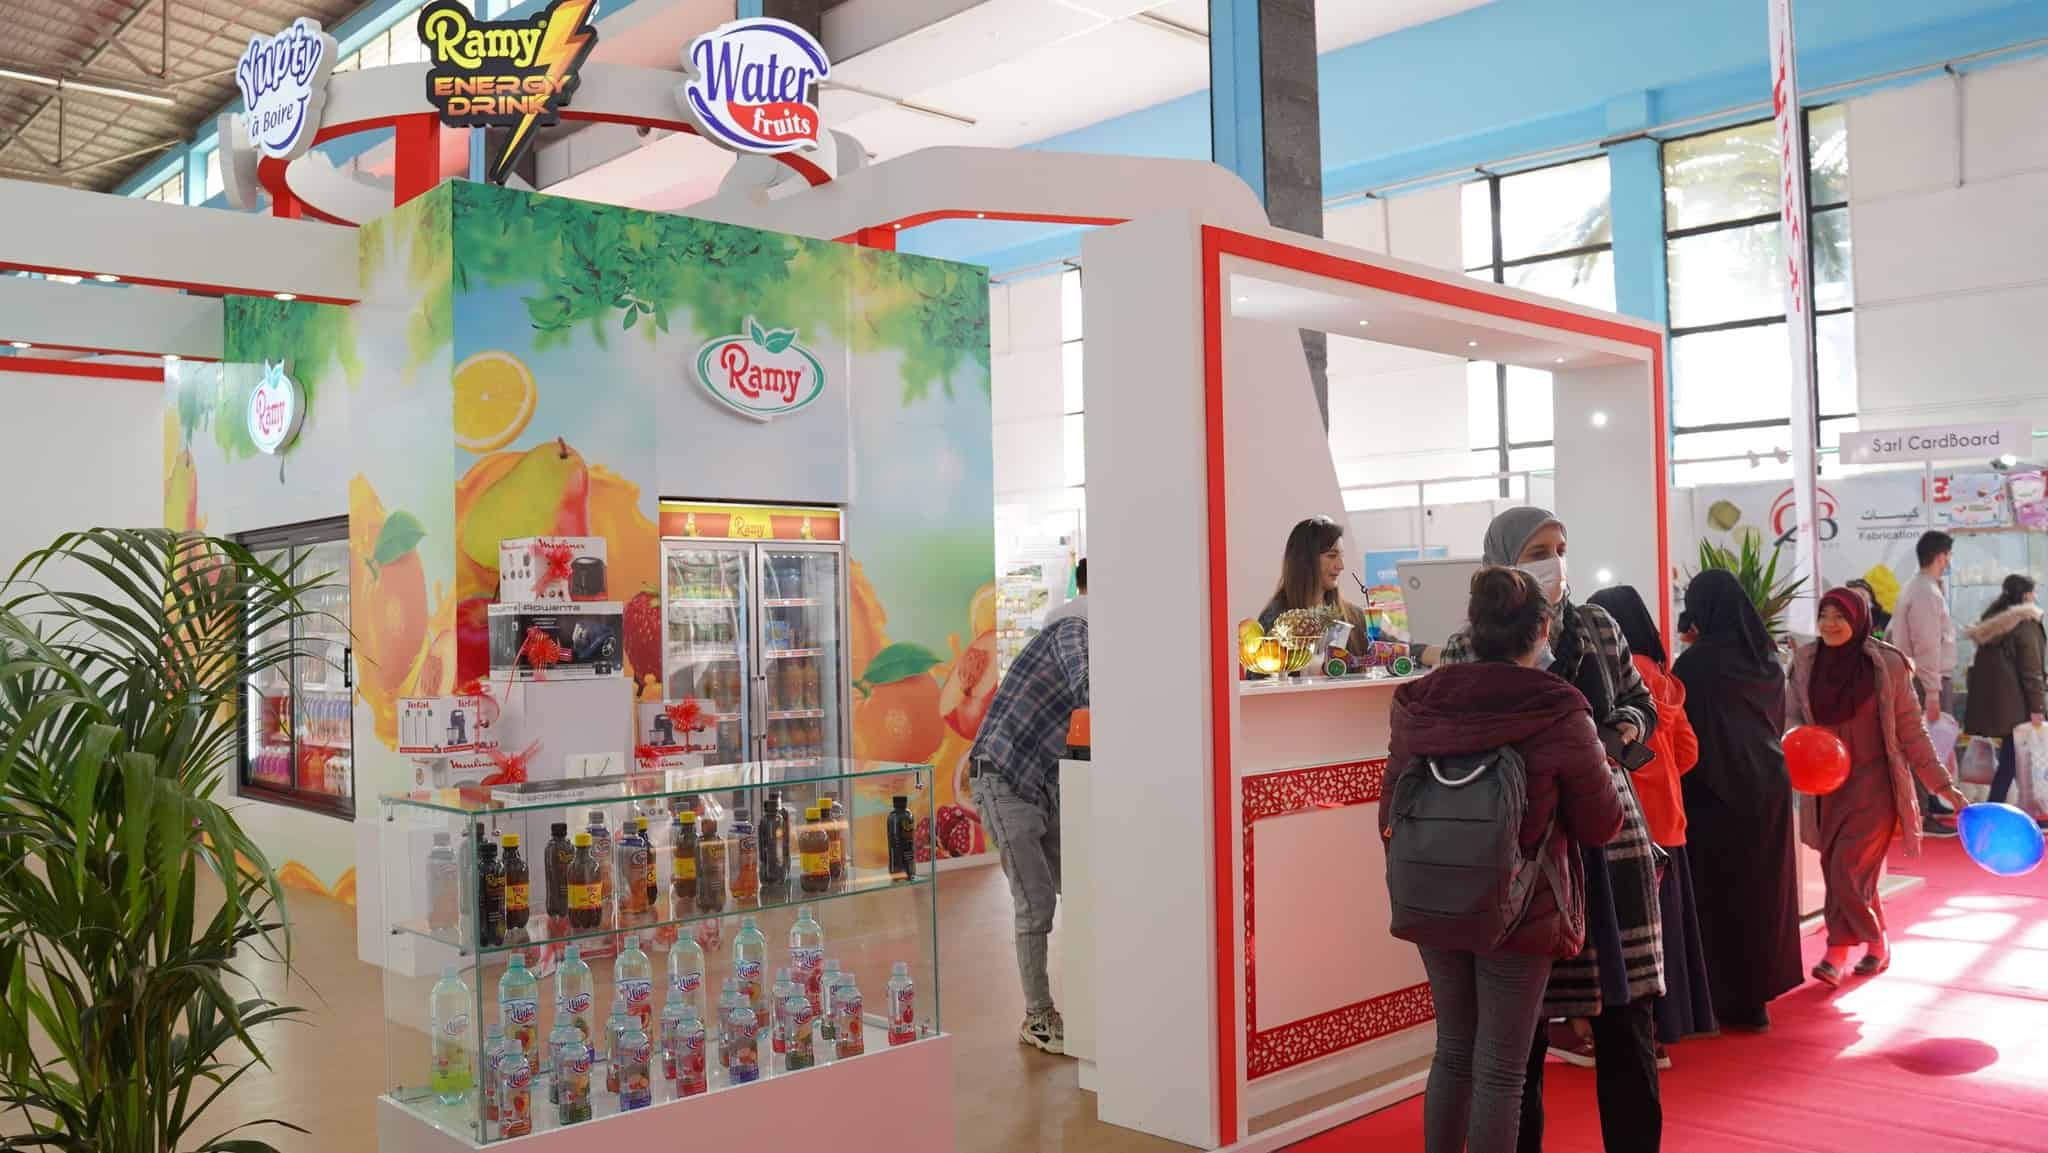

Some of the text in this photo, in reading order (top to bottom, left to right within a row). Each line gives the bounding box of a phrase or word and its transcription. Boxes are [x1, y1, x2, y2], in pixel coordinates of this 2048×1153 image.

[425, 9, 541, 69] Ramy
[435, 75, 571, 96] ENERGY
[693, 39, 814, 104] Water
[263, 104, 293, 132] Boire
[447, 95, 549, 116] DRINK
[752, 107, 811, 136] fruits
[721, 343, 802, 403] Ramy
[256, 389, 285, 435] Ramy
[1872, 430, 2000, 453] Sarl CardBoard
[734, 516, 765, 536] Ramy
[1858, 529, 1920, 542] Fabrication
